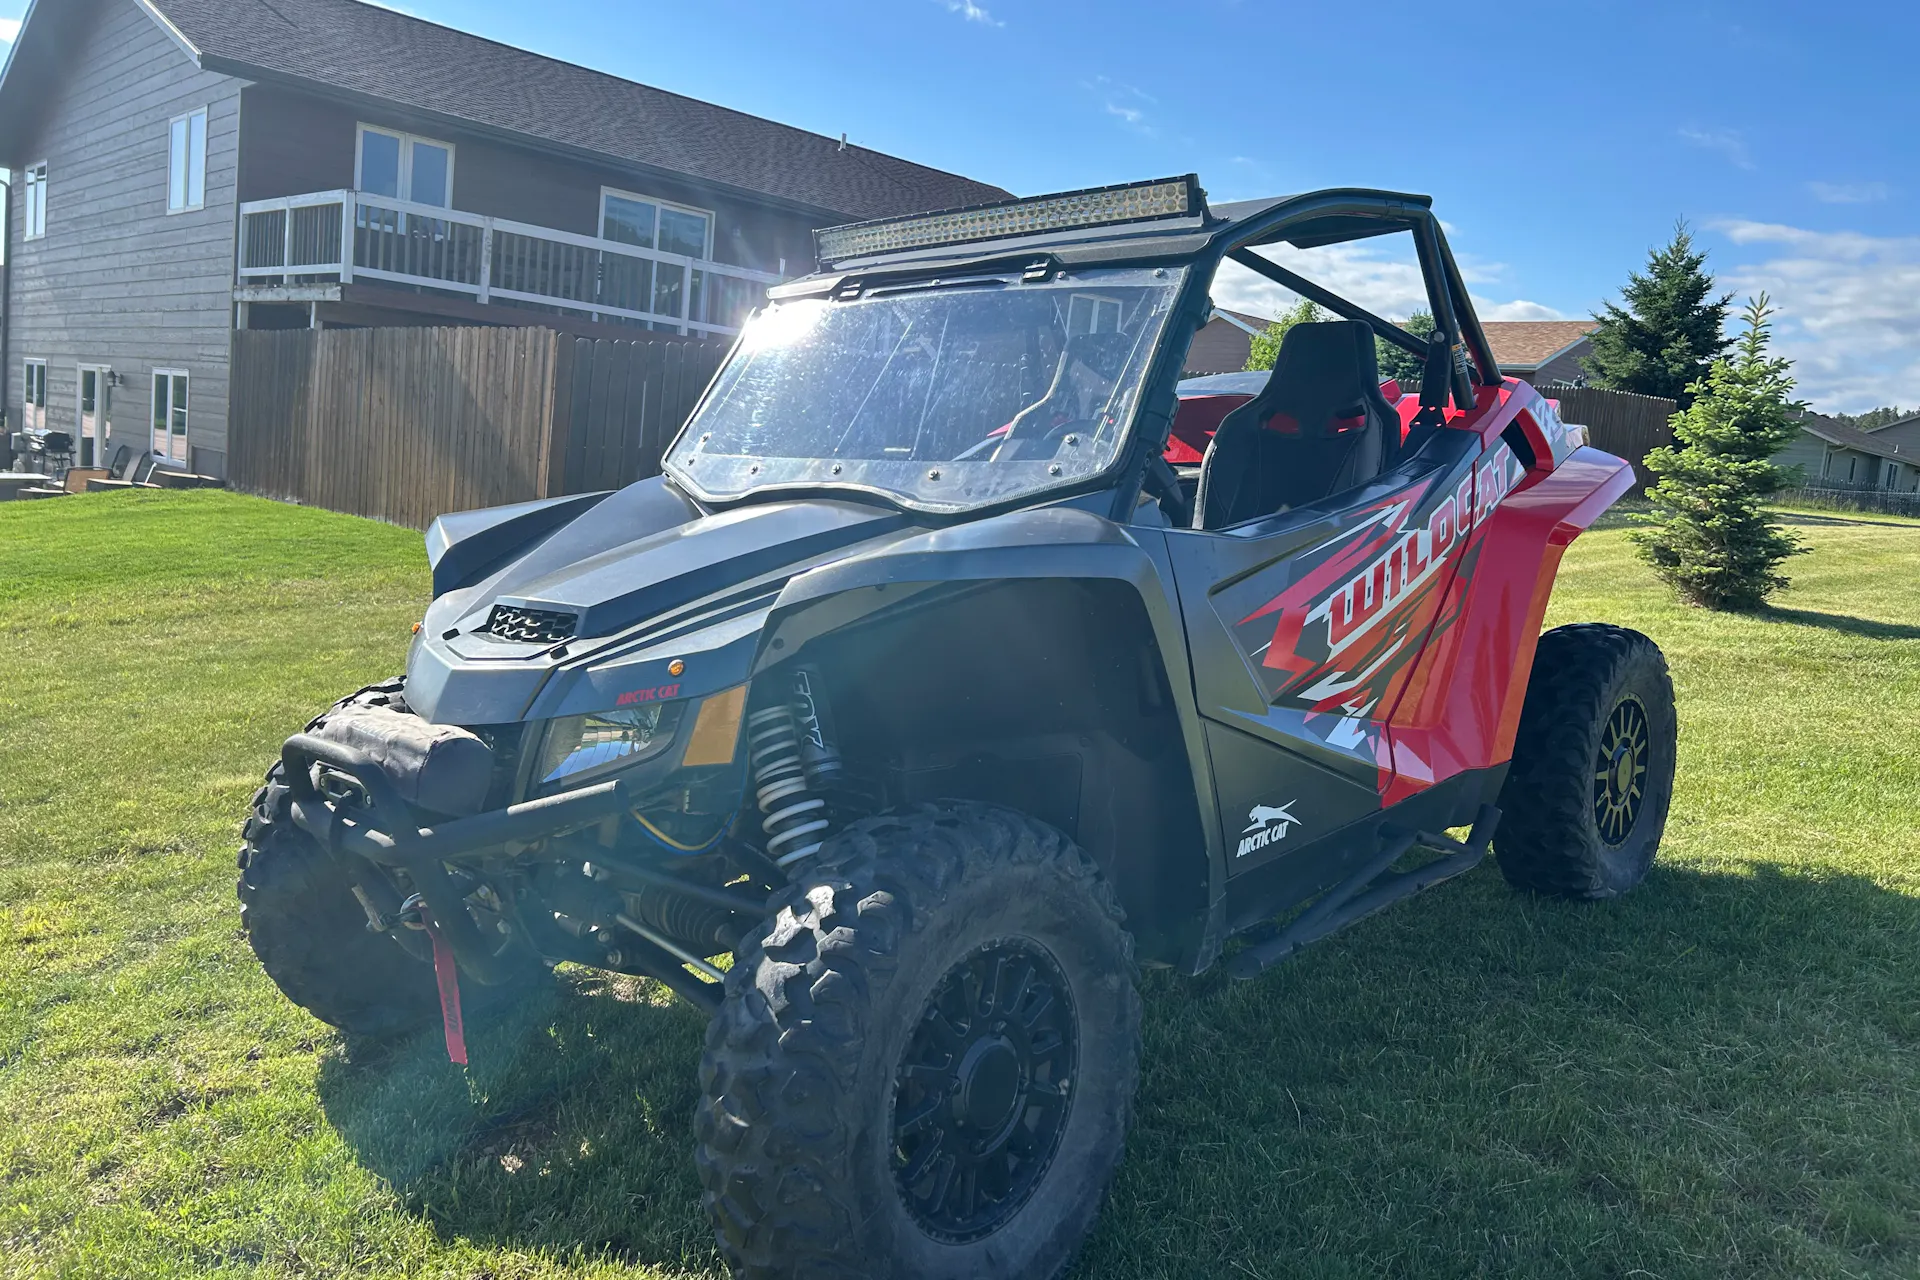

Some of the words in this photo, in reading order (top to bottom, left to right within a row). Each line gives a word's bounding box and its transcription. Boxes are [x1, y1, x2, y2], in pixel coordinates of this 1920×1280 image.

[1327, 442, 1510, 647] WILDCAT
[616, 688, 656, 705] ARCTIC
[658, 684, 680, 699] CAT
[1236, 828, 1271, 858] ARCTIC
[1271, 821, 1289, 842] CAT
